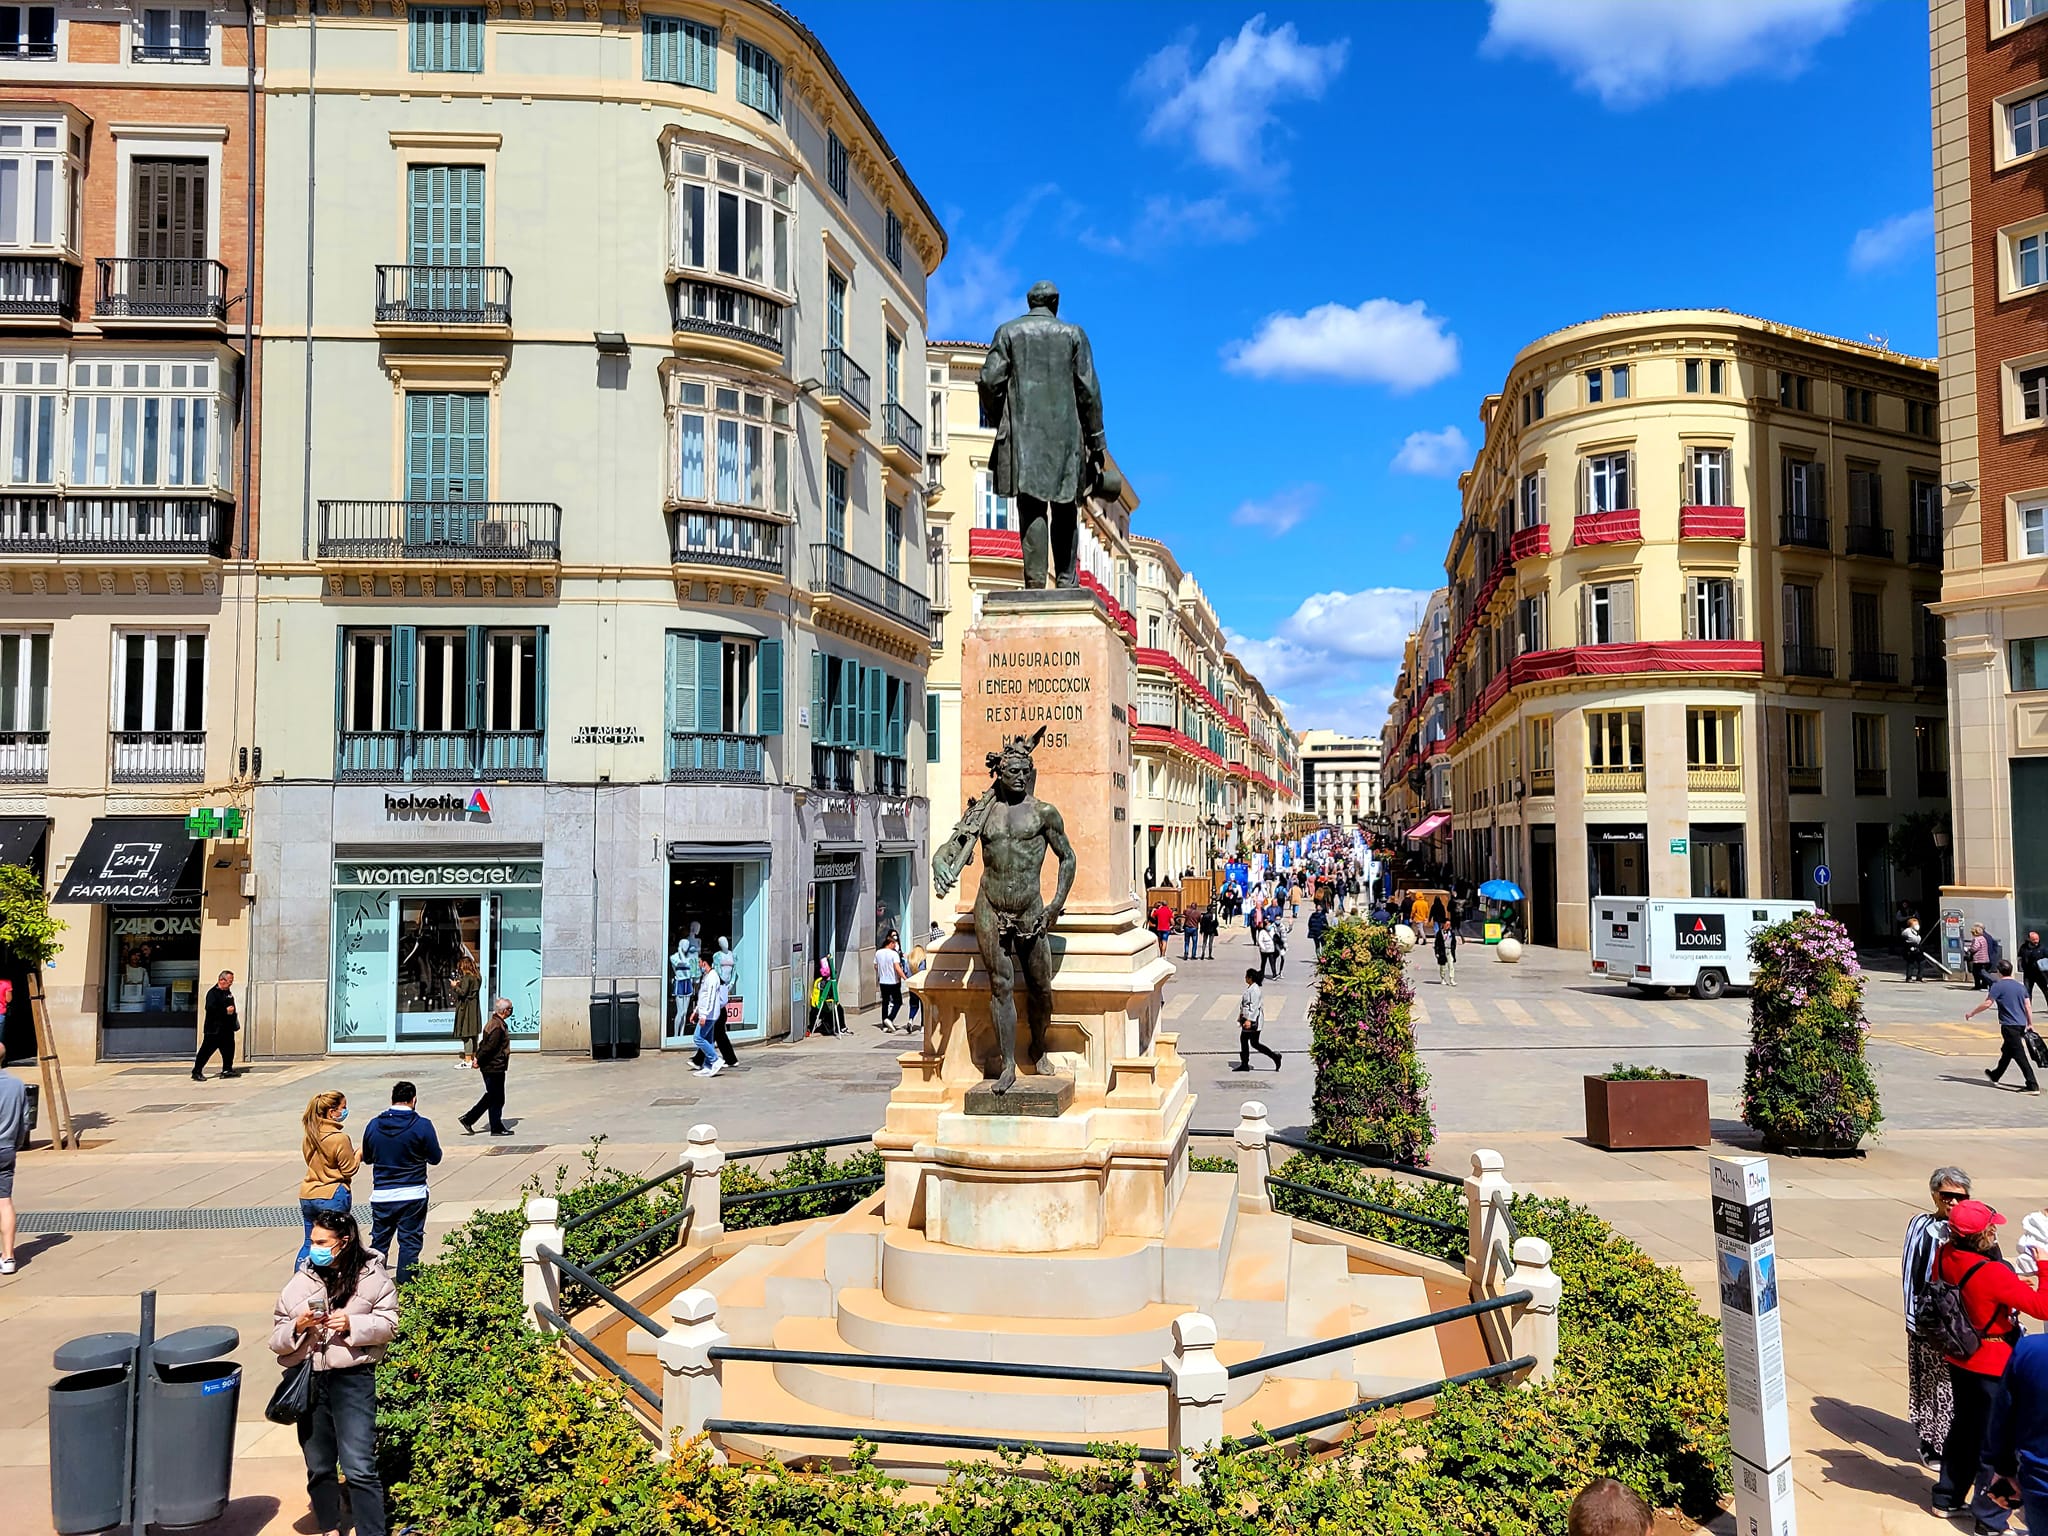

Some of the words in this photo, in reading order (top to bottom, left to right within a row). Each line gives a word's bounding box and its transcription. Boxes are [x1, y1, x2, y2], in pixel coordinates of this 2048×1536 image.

[988, 651, 1080, 667] INAUGURACION
[986, 679, 1022, 694] ENERO
[1028, 677, 1090, 693] MDCCCXCIX
[986, 705, 1083, 722] RESTAURACION
[578, 726, 638, 735] ALAMEDA
[571, 735, 645, 744] PRINCIPAL
[1042, 733, 1068, 748] 1951
[384, 793, 465, 809] helvetia
[113, 855, 148, 866] 24H
[356, 866, 513, 884] women'secret
[68, 884, 160, 897] FARMACIA
[1679, 932, 1722, 945] LOOMIS
